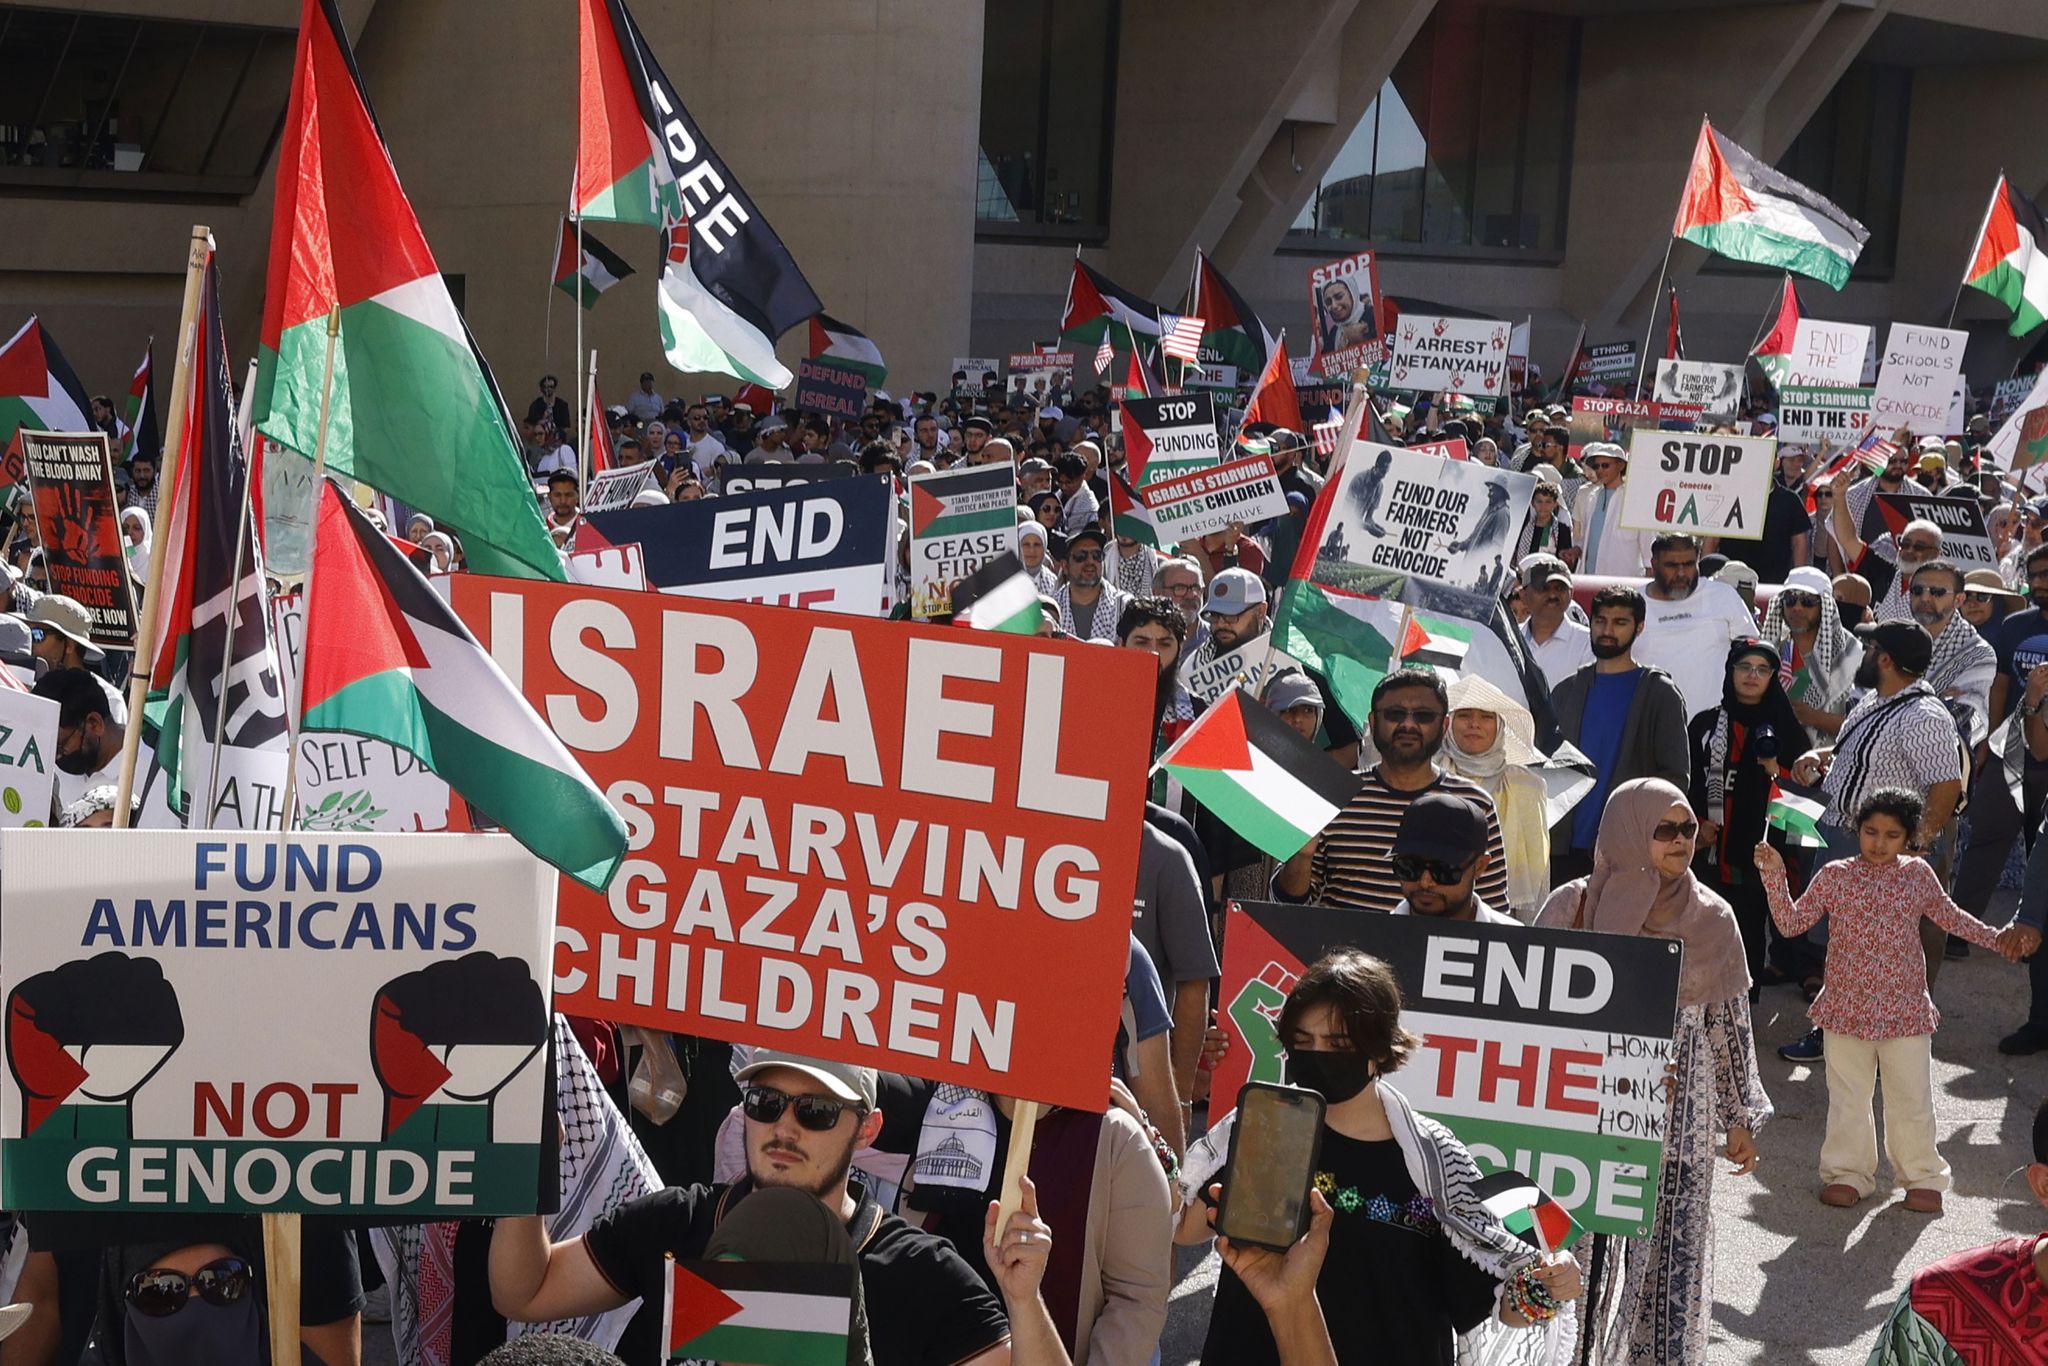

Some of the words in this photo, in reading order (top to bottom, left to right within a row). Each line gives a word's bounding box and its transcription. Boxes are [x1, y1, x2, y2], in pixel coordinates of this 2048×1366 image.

[1312, 253, 1371, 288] STOP
[1321, 347, 1360, 367] STARVING
[1361, 340, 1384, 354] GAZA
[1415, 337, 1487, 355] ARREST
[1592, 343, 1629, 357] ETHNIC
[1811, 329, 1860, 356] END
[1906, 331, 1950, 350] FUND
[1324, 365, 1341, 377] END
[1342, 360, 1359, 371] THE
[1360, 350, 1384, 366] SIEGE
[1395, 354, 1502, 374] NETANYAHU
[1624, 356, 1633, 364] IS
[1807, 352, 1839, 369] THE
[1887, 352, 1954, 369] SCHOOLS
[799, 363, 866, 390] DEFUND
[1200, 370, 1223, 383] HE
[1581, 374, 1602, 384] WAR
[1603, 370, 1632, 380] CRIME
[1682, 374, 1701, 384] FUND
[1702, 375, 1718, 385] OUR
[1902, 373, 1935, 387] NOT
[1995, 376, 2037, 397] HONK
[799, 390, 857, 416] ISREAL
[1583, 400, 1614, 412] STOP
[1615, 402, 1649, 415] GAZA
[1688, 392, 1704, 402] NOT
[1782, 391, 1811, 405] STOP
[1812, 394, 1867, 408] STARVING
[1876, 396, 1944, 420] GENOCIDE
[1158, 401, 1197, 422] STOP
[1782, 408, 1813, 426] END
[1817, 411, 1846, 428] THE
[26, 442, 42, 463] YOU
[43, 443, 67, 463] CAN'T
[68, 445, 100, 463] WASH
[1154, 432, 1216, 453] FUNDING
[30, 460, 45, 478] THE
[45, 462, 73, 480] BLOOD
[74, 463, 102, 481] AWAY
[1660, 440, 1743, 476] STOP
[1148, 483, 1192, 506] ISRAEL
[1192, 478, 1206, 492] IS
[1206, 460, 1269, 490] STARVING
[951, 494, 970, 506] STAND
[970, 491, 1000, 503] TOGETHER
[1000, 489, 1012, 499] FOR
[954, 503, 976, 514] JUSTICE
[977, 501, 990, 511] AND
[990, 498, 1009, 509] PEACE
[1155, 499, 1205, 524] GAZA'S
[1204, 479, 1276, 511] CHILDREN
[1392, 479, 1435, 508] FUND
[1435, 488, 1470, 514] OUR
[1655, 488, 1744, 530] GAZA
[1181, 506, 1264, 535] #LETGAZALIVE
[1385, 502, 1460, 540] FARMERS,
[1909, 502, 1973, 528] ETHNIC
[708, 497, 845, 571] END
[924, 533, 1006, 561] CEASE
[1399, 527, 1434, 552] NOT
[1371, 544, 1449, 579] GENOCIDE
[1976, 545, 1992, 563] IS
[50, 563, 73, 583] STOP
[73, 566, 120, 588] FUNDING
[61, 584, 114, 608] GENOCIDE
[922, 602, 943, 614] STOP
[103, 607, 128, 627] NOW
[1188, 653, 1243, 692] FUND
[490, 590, 1110, 821] ISRAEL
[301, 739, 373, 787] SELF
[605, 779, 1101, 921] STARVING
[194, 842, 383, 893] FUND
[80, 898, 478, 951] AMERICANS
[608, 859, 949, 978] GAZA’S
[1421, 934, 1614, 1015] END
[555, 925, 1016, 1074] CHILDREN
[1607, 1033, 1670, 1061] HONK
[1422, 1033, 1603, 1116] THE
[1601, 1074, 1665, 1105] HONK
[193, 1081, 359, 1139] NOT
[948, 1106, 983, 1121] القدس
[1597, 1107, 1662, 1139] HONK
[66, 1146, 476, 1206] GENOCIDE
